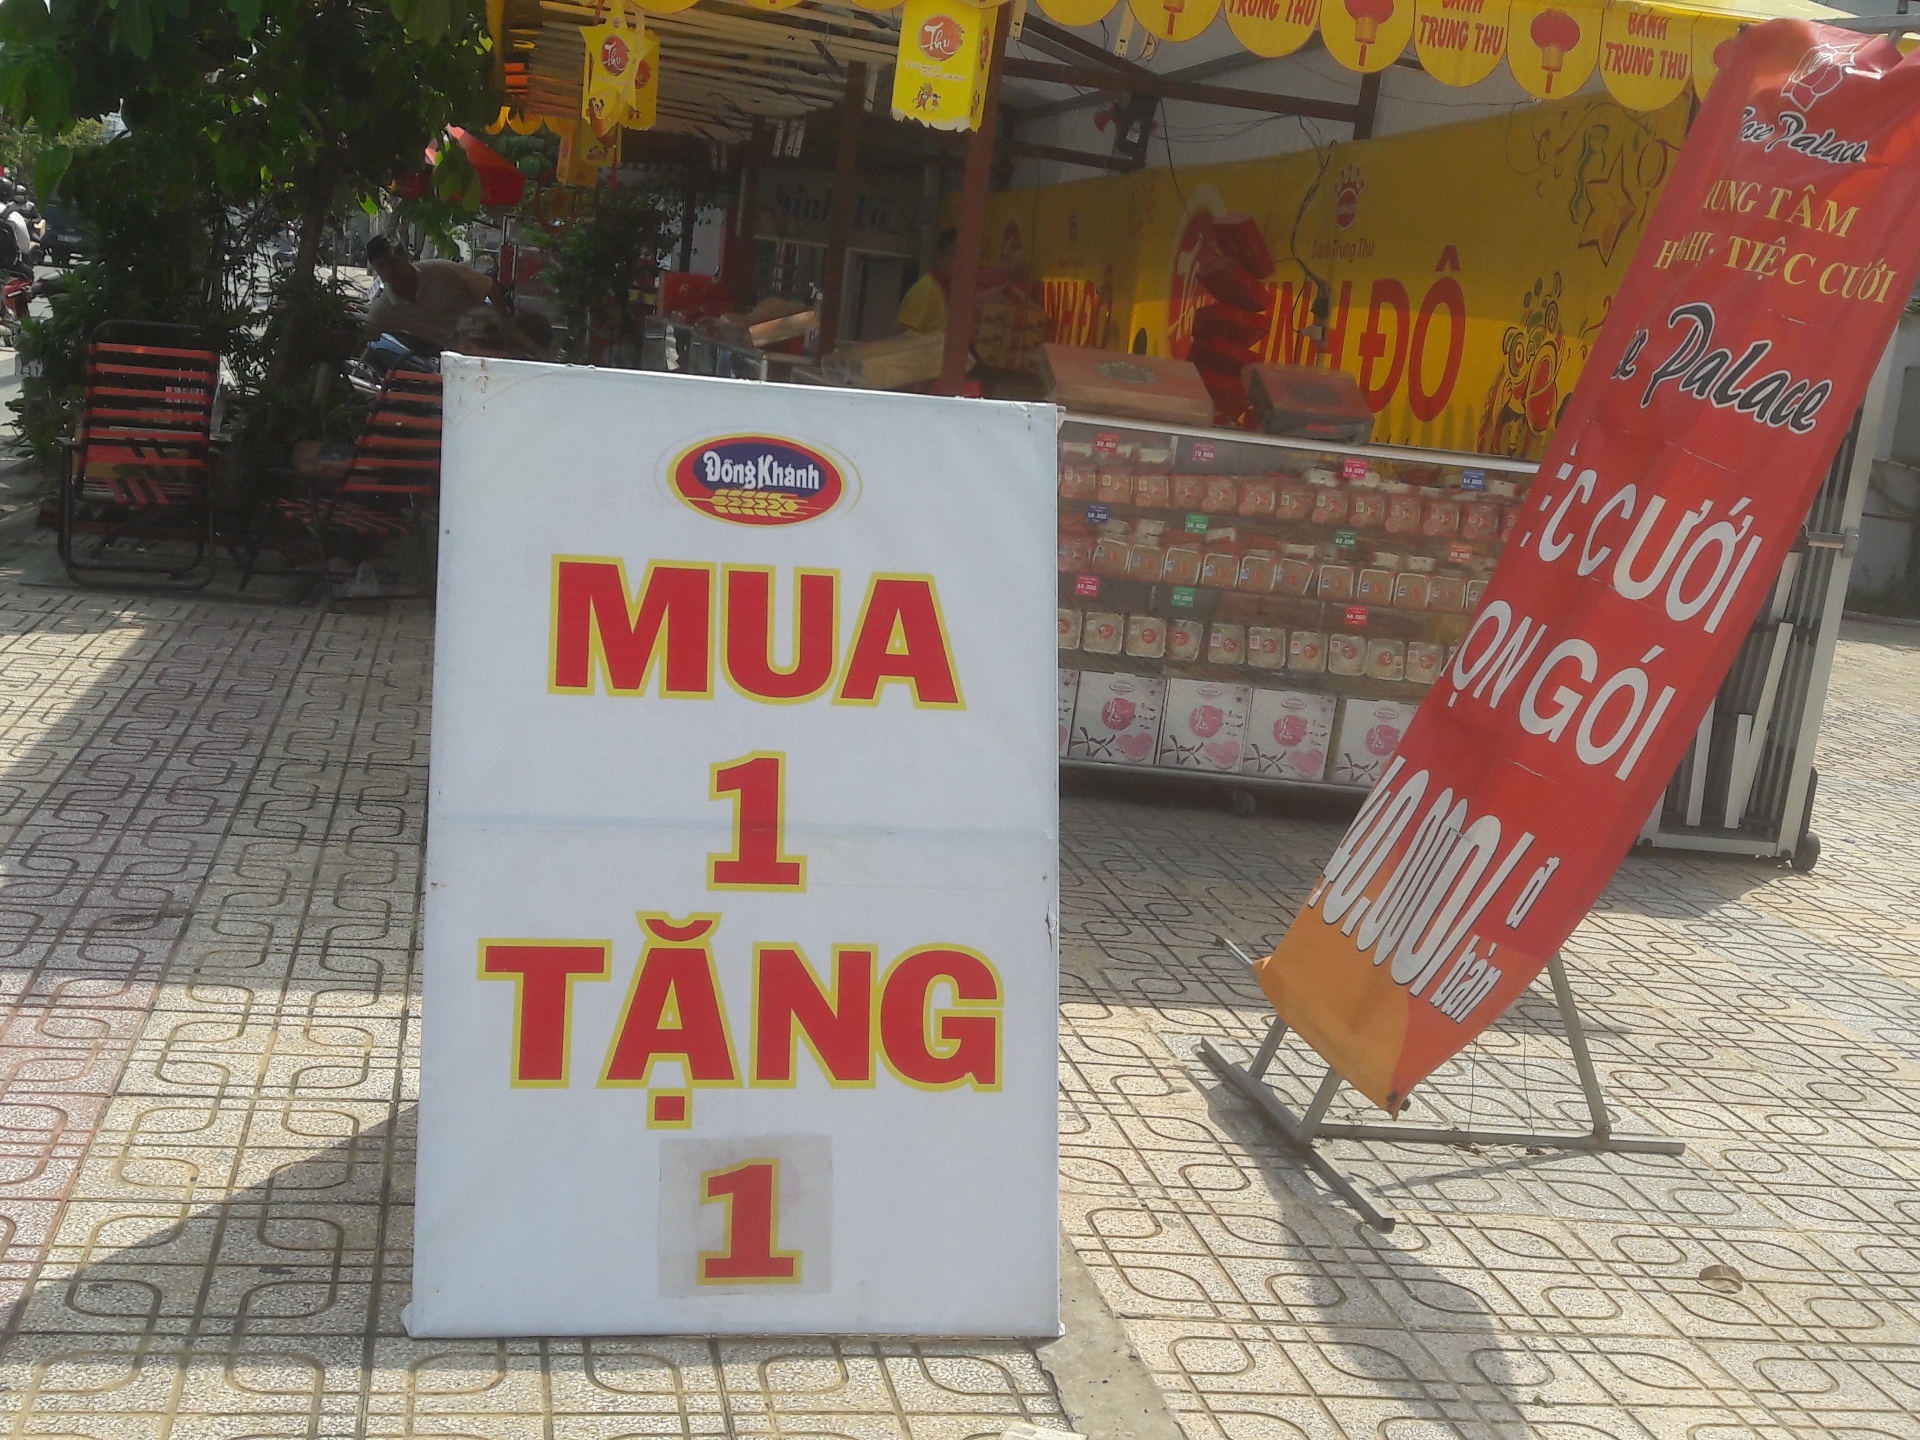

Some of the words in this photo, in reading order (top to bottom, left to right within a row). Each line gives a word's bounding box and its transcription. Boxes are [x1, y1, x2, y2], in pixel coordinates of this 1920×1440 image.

[1419, 14, 1470, 51] TRUNG
[1473, 23, 1505, 56] THU
[1604, 42, 1655, 76] TRUNG
[1660, 49, 1688, 80] THU
[1764, 110, 1868, 164] Palace
[1724, 236, 1817, 286] TIỆC
[1819, 258, 1898, 304] CƯỚI
[1764, 184, 1860, 238] TÂM
[1358, 243, 1466, 420] ĐÔ
[1639, 301, 1834, 434] Palace
[1577, 483, 1763, 634] CƯỚI
[547, 553, 967, 711] MUA
[1518, 637, 1676, 781] GÓI
[706, 750, 807, 892] 1
[477, 911, 1004, 1129] TẶNG
[698, 1158, 802, 1286] 1
